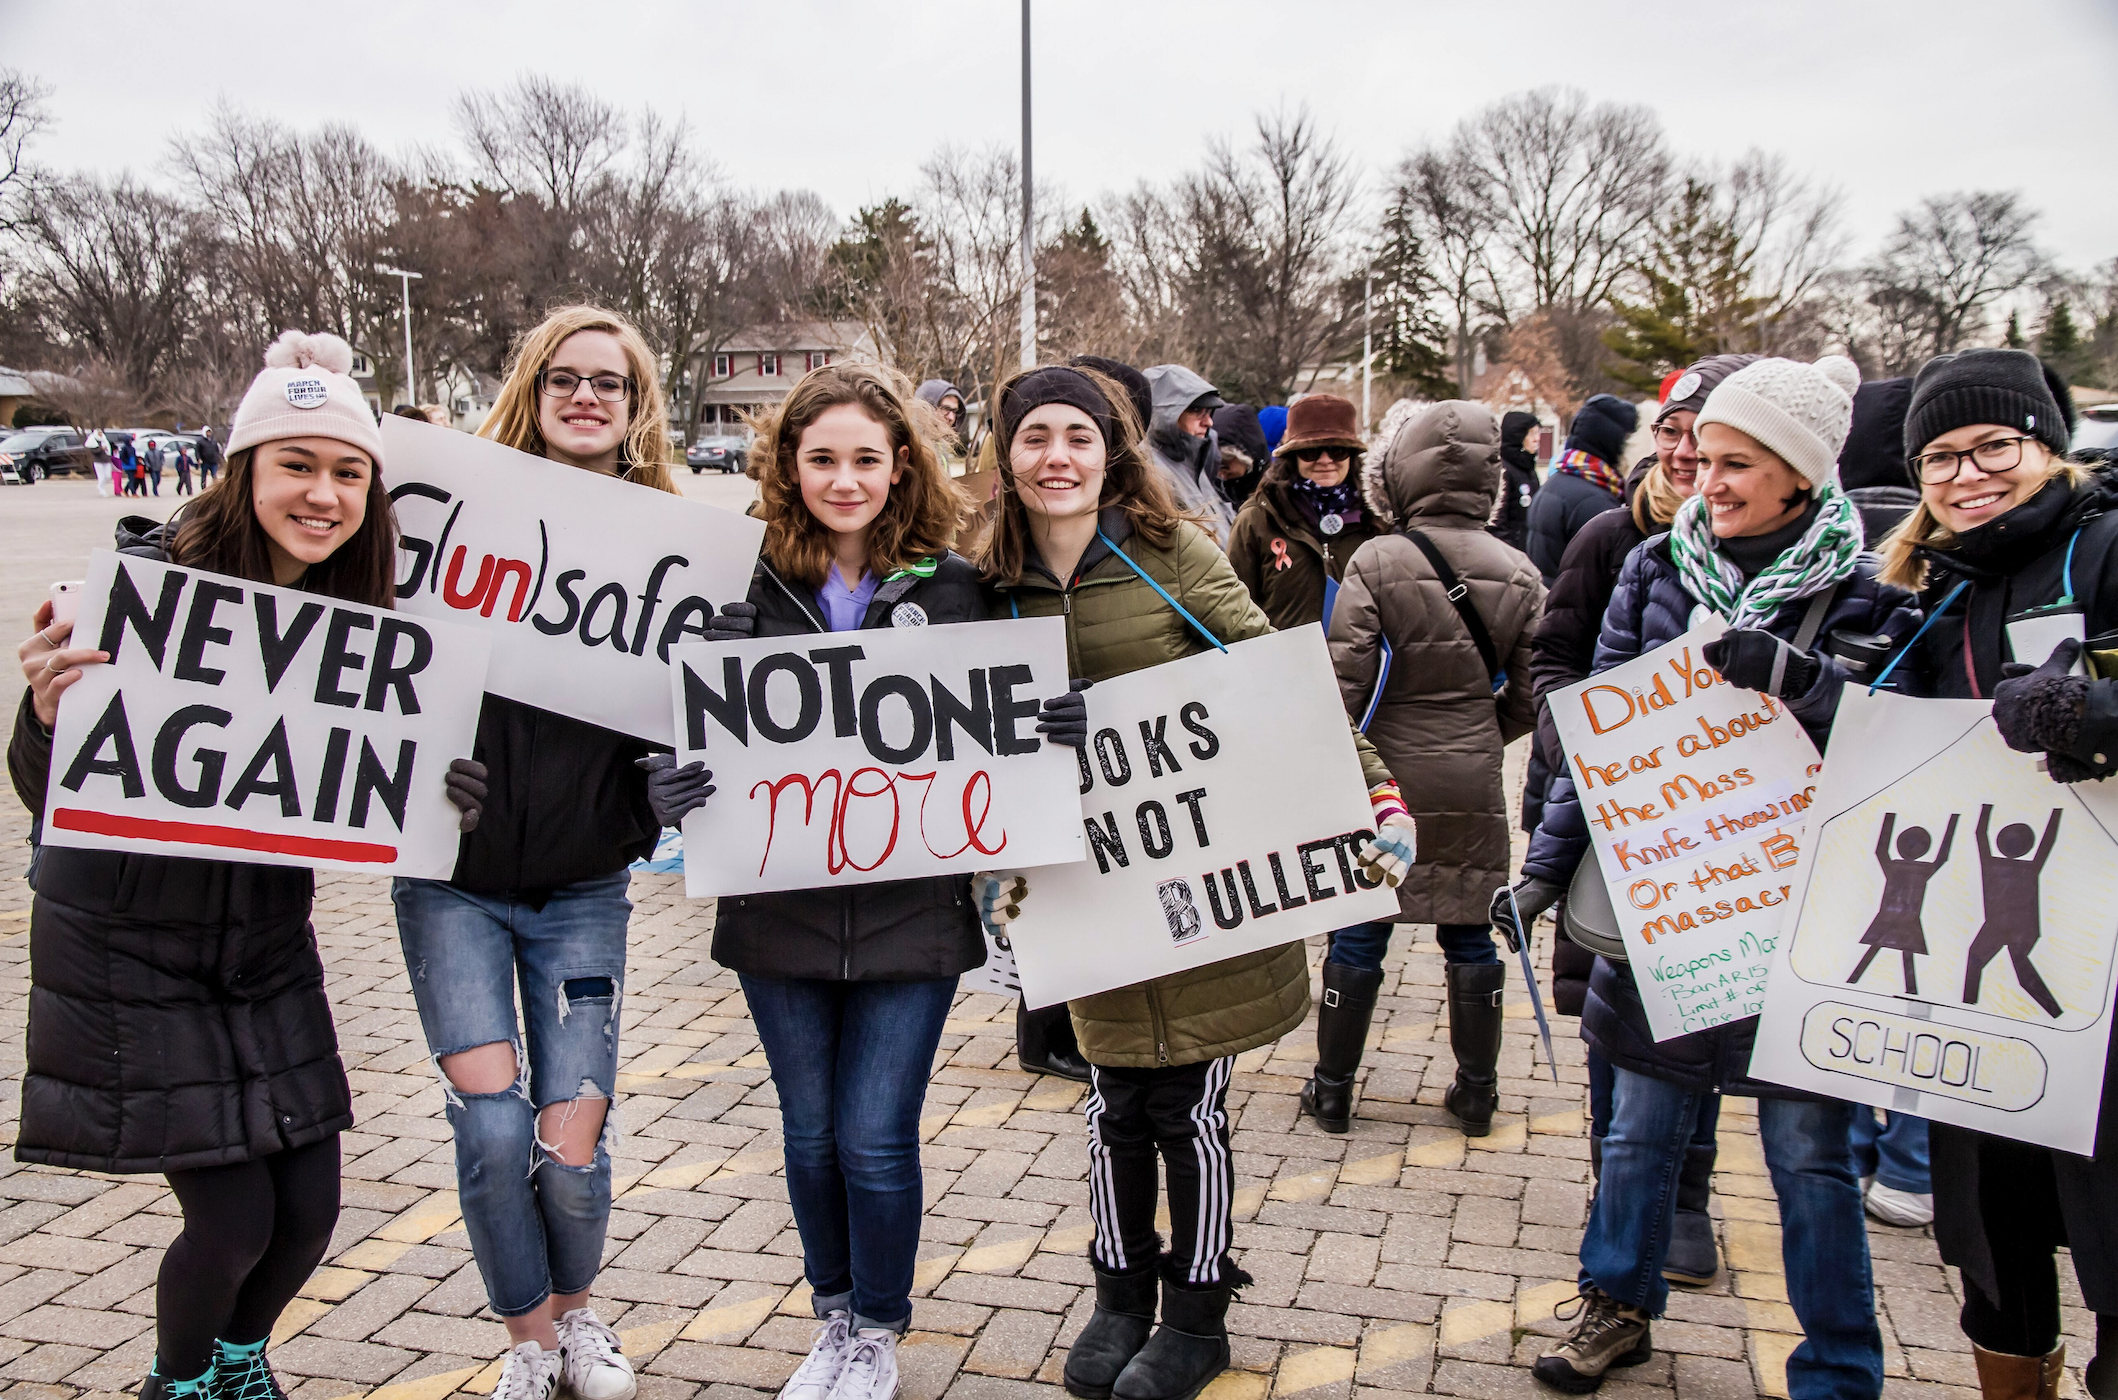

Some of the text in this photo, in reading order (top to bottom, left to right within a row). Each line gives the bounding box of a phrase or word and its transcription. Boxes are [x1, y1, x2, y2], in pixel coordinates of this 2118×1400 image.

[287, 380, 321, 388] MARCH
[98, 560, 433, 716] NEVER
[682, 645, 1041, 765] NOT ONE
[1573, 691, 1781, 790] hear about
[1580, 672, 1677, 735] Did
[60, 688, 417, 834] AGAIN
[750, 767, 1007, 877] more
[1084, 787, 1210, 875] NOT
[1591, 768, 1757, 832] the Mass
[1155, 828, 1384, 943] BULLETS
[1612, 827, 1701, 872] Knife
[1627, 878, 1678, 910] Or
[1688, 852, 1762, 893] that
[1647, 949, 1732, 982] Weapons
[1661, 983, 1717, 1000] Ban
[1829, 1017, 1993, 1093] SCHOOL
